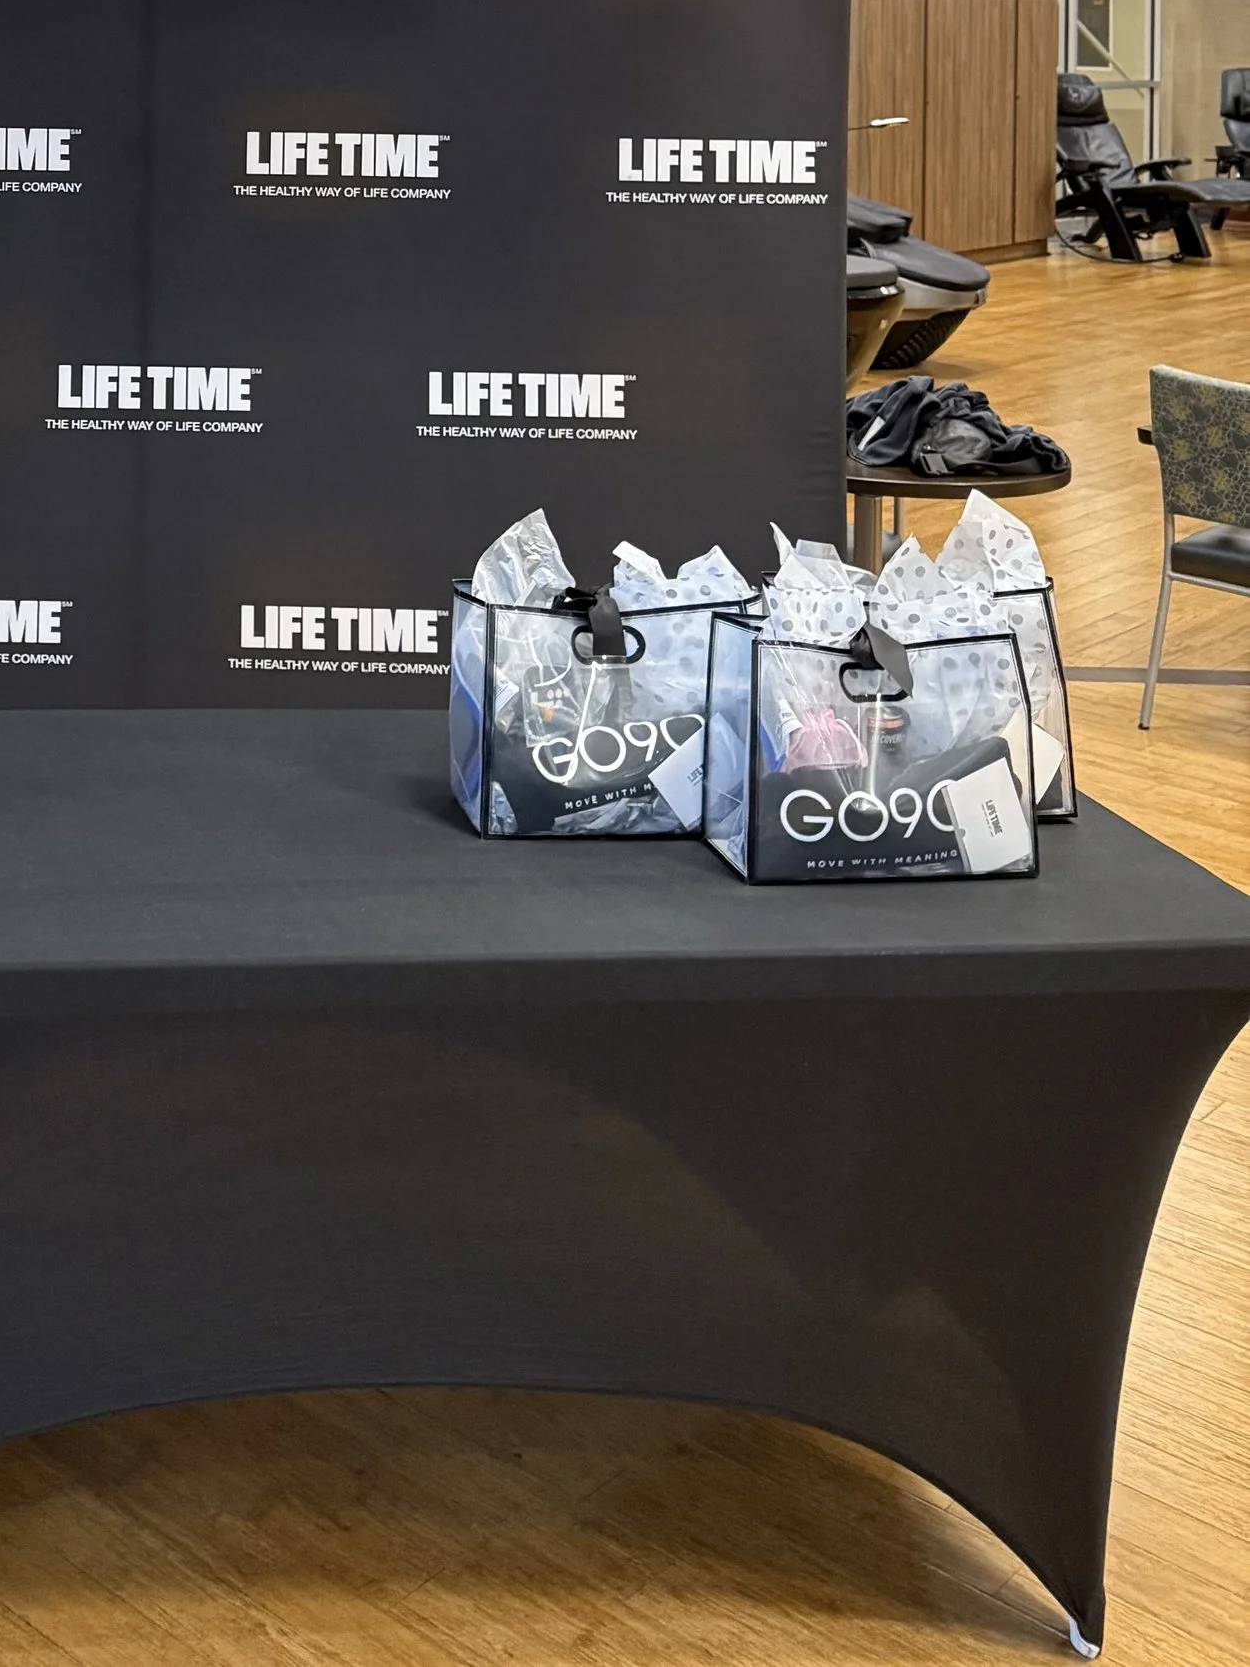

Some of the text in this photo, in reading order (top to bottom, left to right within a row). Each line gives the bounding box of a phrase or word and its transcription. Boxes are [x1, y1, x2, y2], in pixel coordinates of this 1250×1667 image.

[246, 132, 329, 175] LIFE
[335, 133, 439, 177] TIME
[619, 138, 703, 182] LIFE
[709, 140, 816, 183] TIME
[21, 181, 83, 193] COMPANY
[232, 185, 452, 200] THE HEALTHY WAY OF LIFE COMPANY
[605, 191, 829, 205] THE HEALTHY WAY OF LIFE COMPANY
[58, 365, 141, 409] LIFE
[147, 367, 252, 411] TIME
[429, 372, 512, 416] LIFE
[518, 373, 626, 418] TIME
[44, 418, 264, 434] THE HEALTHY WAY OF LIFE COMPANY
[415, 425, 638, 441] THE HEALTHY WAY OF LIFE COMPANY
[241, 605, 325, 650] LIFE
[331, 607, 438, 653] TIME
[11, 653, 74, 665] COMPANY
[227, 657, 452, 676] THE HEALTHY WAY OF LIFE COMPANY
[565, 795, 599, 810] MOVE
[604, 786, 637, 801] WITH
[807, 849, 959, 869] MOVE WITH MEANING
